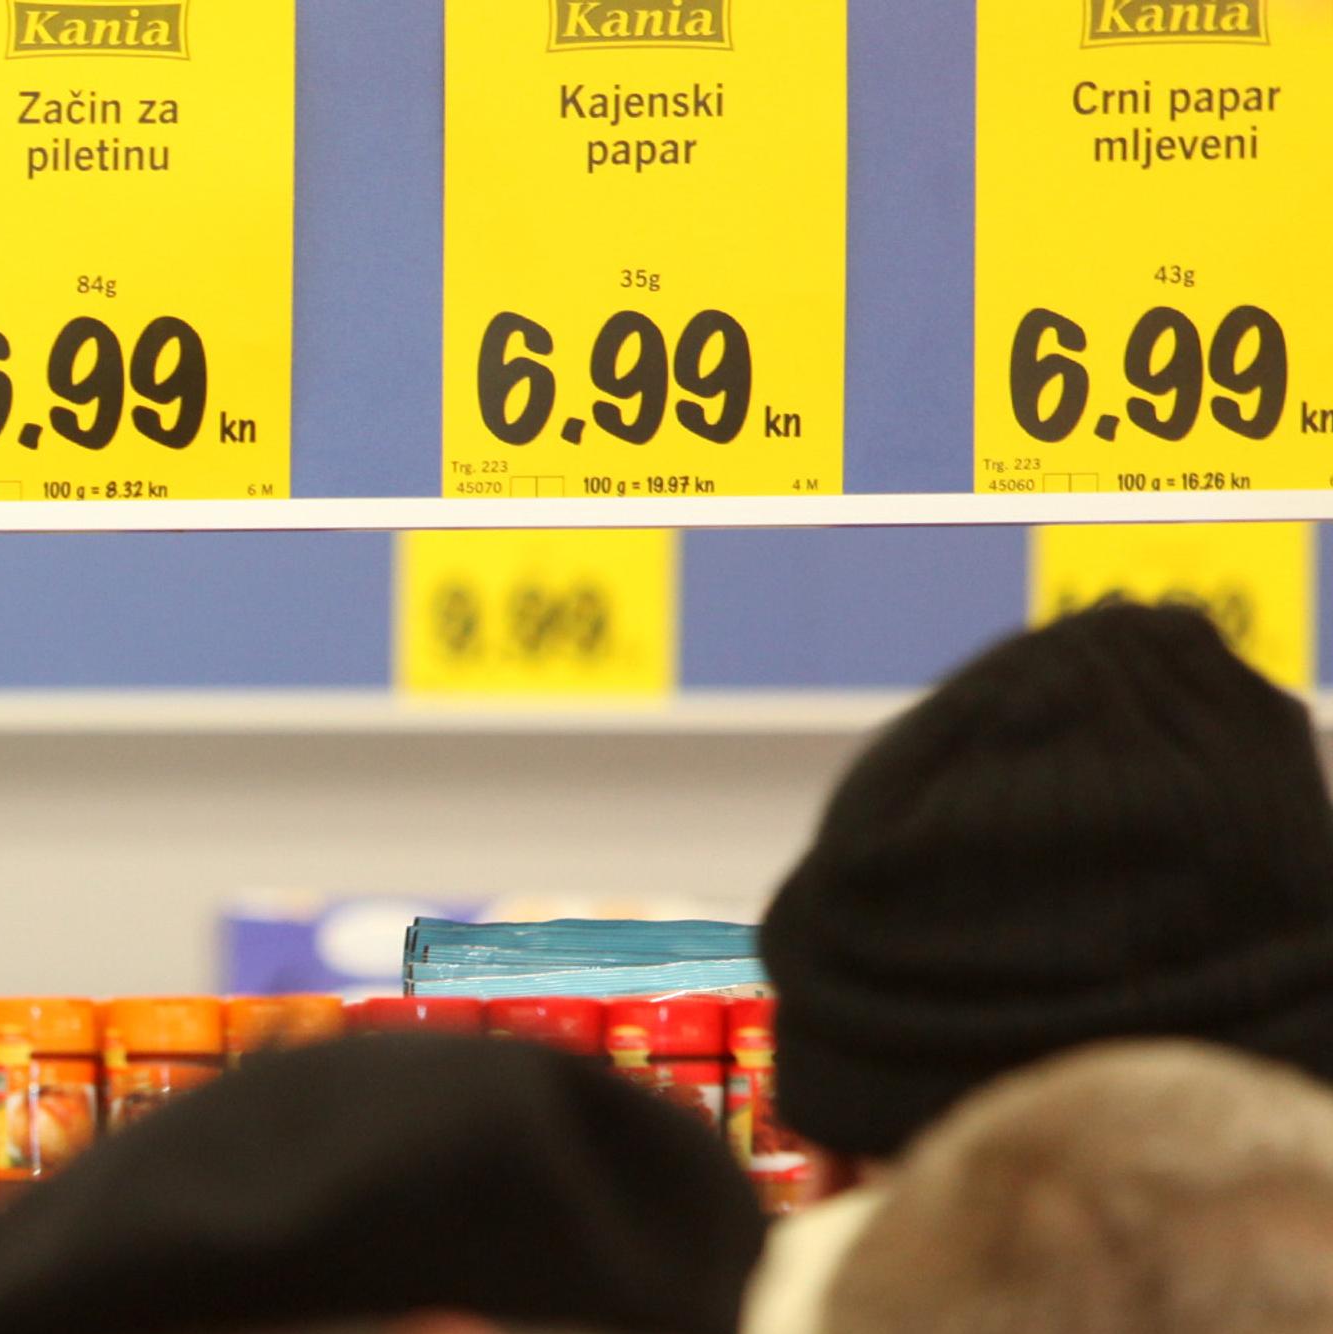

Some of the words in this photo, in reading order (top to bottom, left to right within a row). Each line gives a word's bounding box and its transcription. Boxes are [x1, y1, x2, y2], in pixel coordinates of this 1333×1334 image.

[22, 7, 173, 48] Kania
[564, 0, 717, 39] Kania
[1097, 0, 1251, 34] Kania
[18, 91, 120, 124] Začin
[138, 100, 177, 123] za
[561, 83, 722, 126] Kajenski
[1073, 81, 1150, 115] Crni
[1170, 87, 1280, 124] papar
[28, 138, 168, 179] piletinu
[588, 140, 696, 173] papar
[1095, 128, 1257, 169] mljeveni
[77, 276, 116, 298] 84g
[620, 269, 661, 292] 35g
[1154, 265, 1194, 287] 43g
[478, 310, 752, 446] 6.99
[765, 406, 800, 437] kn
[1010, 305, 1288, 443] 6.99
[1301, 402, 1333, 433] kn
[220, 412, 255, 443] kn
[450, 460, 476, 476] Trg.
[481, 460, 509, 474] 223
[982, 458, 1009, 474] Trg.
[1013, 457, 1042, 471] 223
[43, 481, 72, 500] 100
[105, 480, 143, 499] 8.32
[148, 481, 168, 498] kn
[246, 483, 257, 497] 6
[261, 483, 274, 496] M
[456, 480, 503, 495] 45070
[583, 476, 612, 495] 100
[646, 475, 690, 494] 19.97
[694, 476, 715, 493] kn
[792, 479, 801, 491] 4
[806, 478, 819, 491] M
[988, 478, 1035, 492] 45060
[1117, 473, 1147, 492] 100
[1181, 471, 1226, 491] 16.26
[1230, 472, 1251, 490] kn
